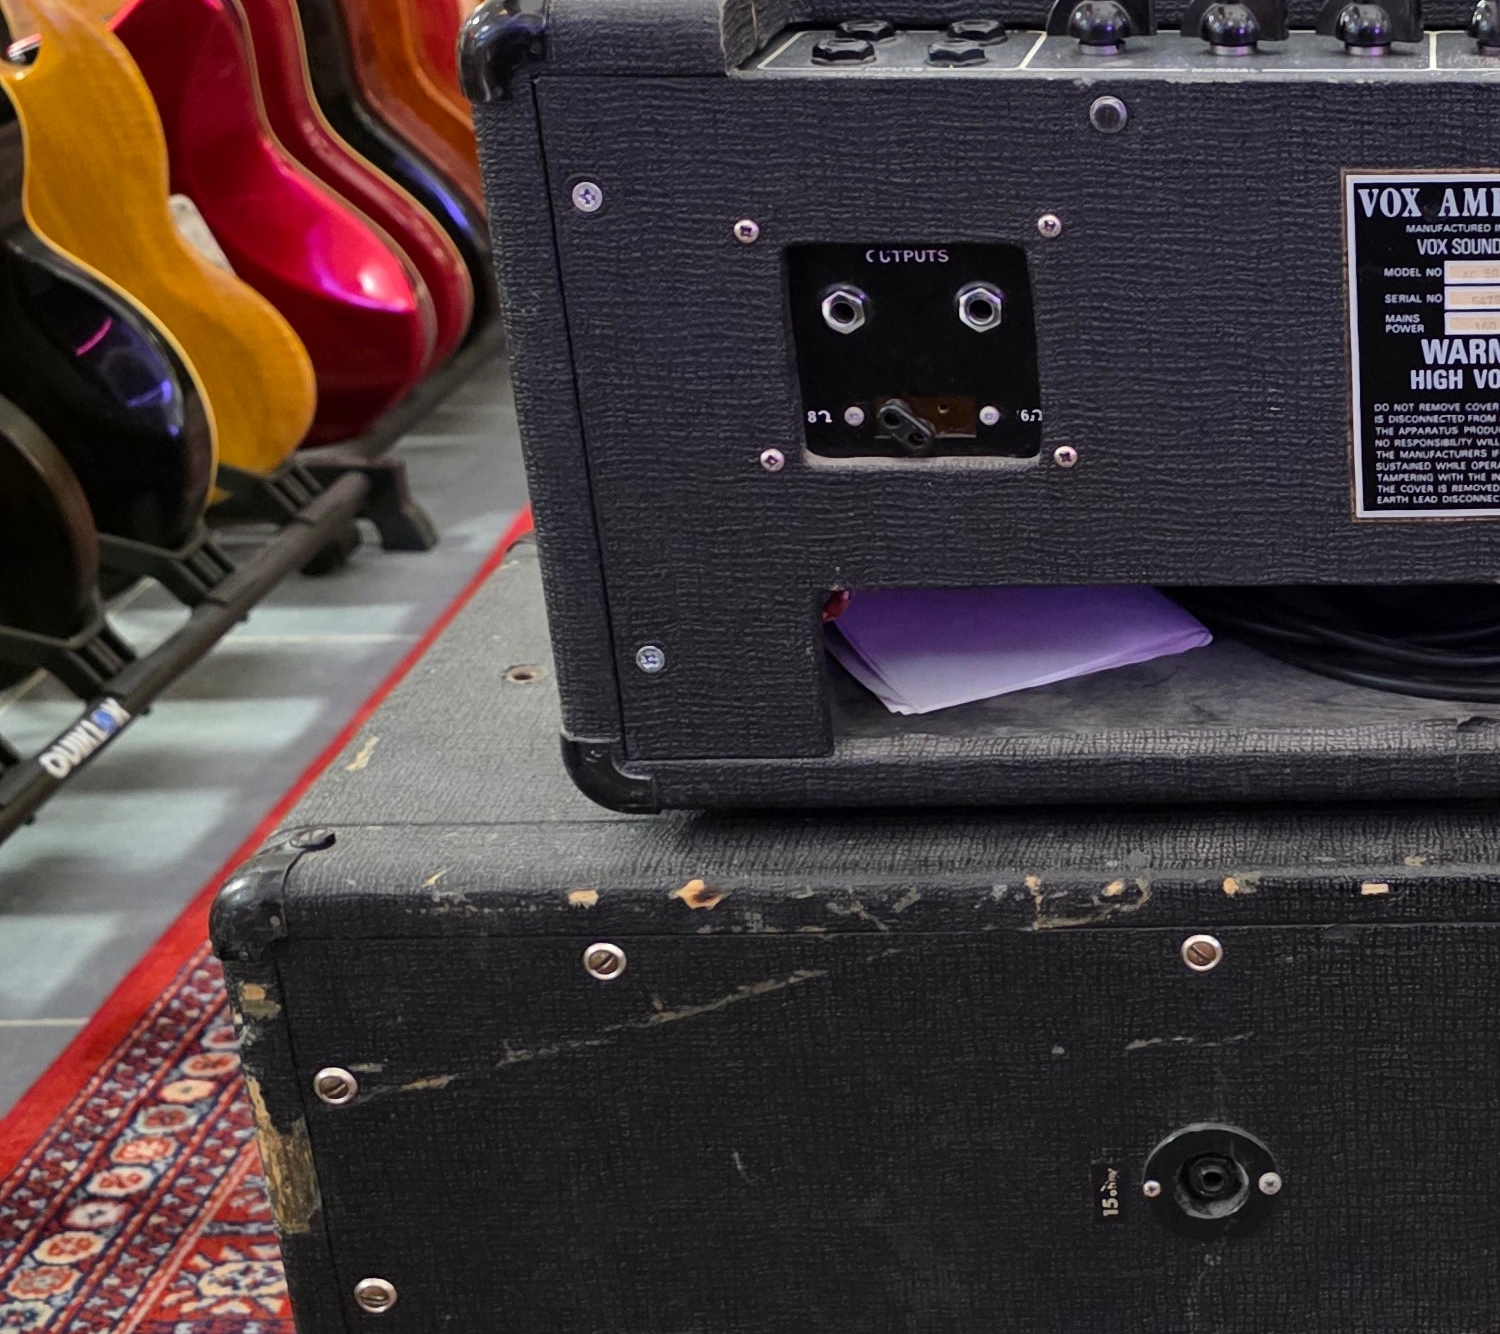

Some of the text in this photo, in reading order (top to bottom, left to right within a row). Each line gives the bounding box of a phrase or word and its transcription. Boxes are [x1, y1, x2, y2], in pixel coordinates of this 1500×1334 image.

[1358, 187, 1422, 217] VOX
[1406, 224, 1491, 233] MANUFACTURED
[1417, 238, 1448, 255] VOX
[1384, 268, 1421, 277] MODEL
[1426, 268, 1442, 277] NO
[1385, 295, 1422, 303] SERIAL
[1426, 294, 1443, 303] NO
[1385, 314, 1420, 323] MAINS
[1386, 324, 1424, 333] POWER
[1410, 369, 1463, 389] HIGH
[1374, 403, 1389, 412] DO
[1393, 403, 1415, 412] NOT
[1418, 403, 1461, 411] REMOVE
[1465, 402, 1500, 411] COVER
[1374, 415, 1384, 423] IS
[1388, 414, 1465, 423] DISCONNECTED
[1468, 414, 1497, 422] FROM
[1376, 427, 1394, 435] THE
[1399, 426, 1459, 435] APPARATUS
[1375, 439, 1391, 448] NO
[1394, 438, 1472, 448] RESPONSIBILITY
[1476, 438, 1500, 447] WILL
[1376, 450, 1394, 459] THE
[1400, 449, 1487, 459] MANUFACTURERS
[1491, 449, 1500, 458] IF
[1376, 462, 1431, 471] SUSTAINED
[1435, 461, 1466, 471] WHILE
[1377, 473, 1433, 482] TAMPERING
[1438, 473, 1464, 482] WITH
[1467, 472, 1486, 481] THE
[1378, 485, 1397, 494] THE
[1401, 484, 1433, 493] COVER
[1438, 484, 1448, 493] IS
[1452, 483, 1500, 493] REMOVED
[1377, 495, 1409, 504] EARTH
[1413, 495, 1438, 504] LEAD
